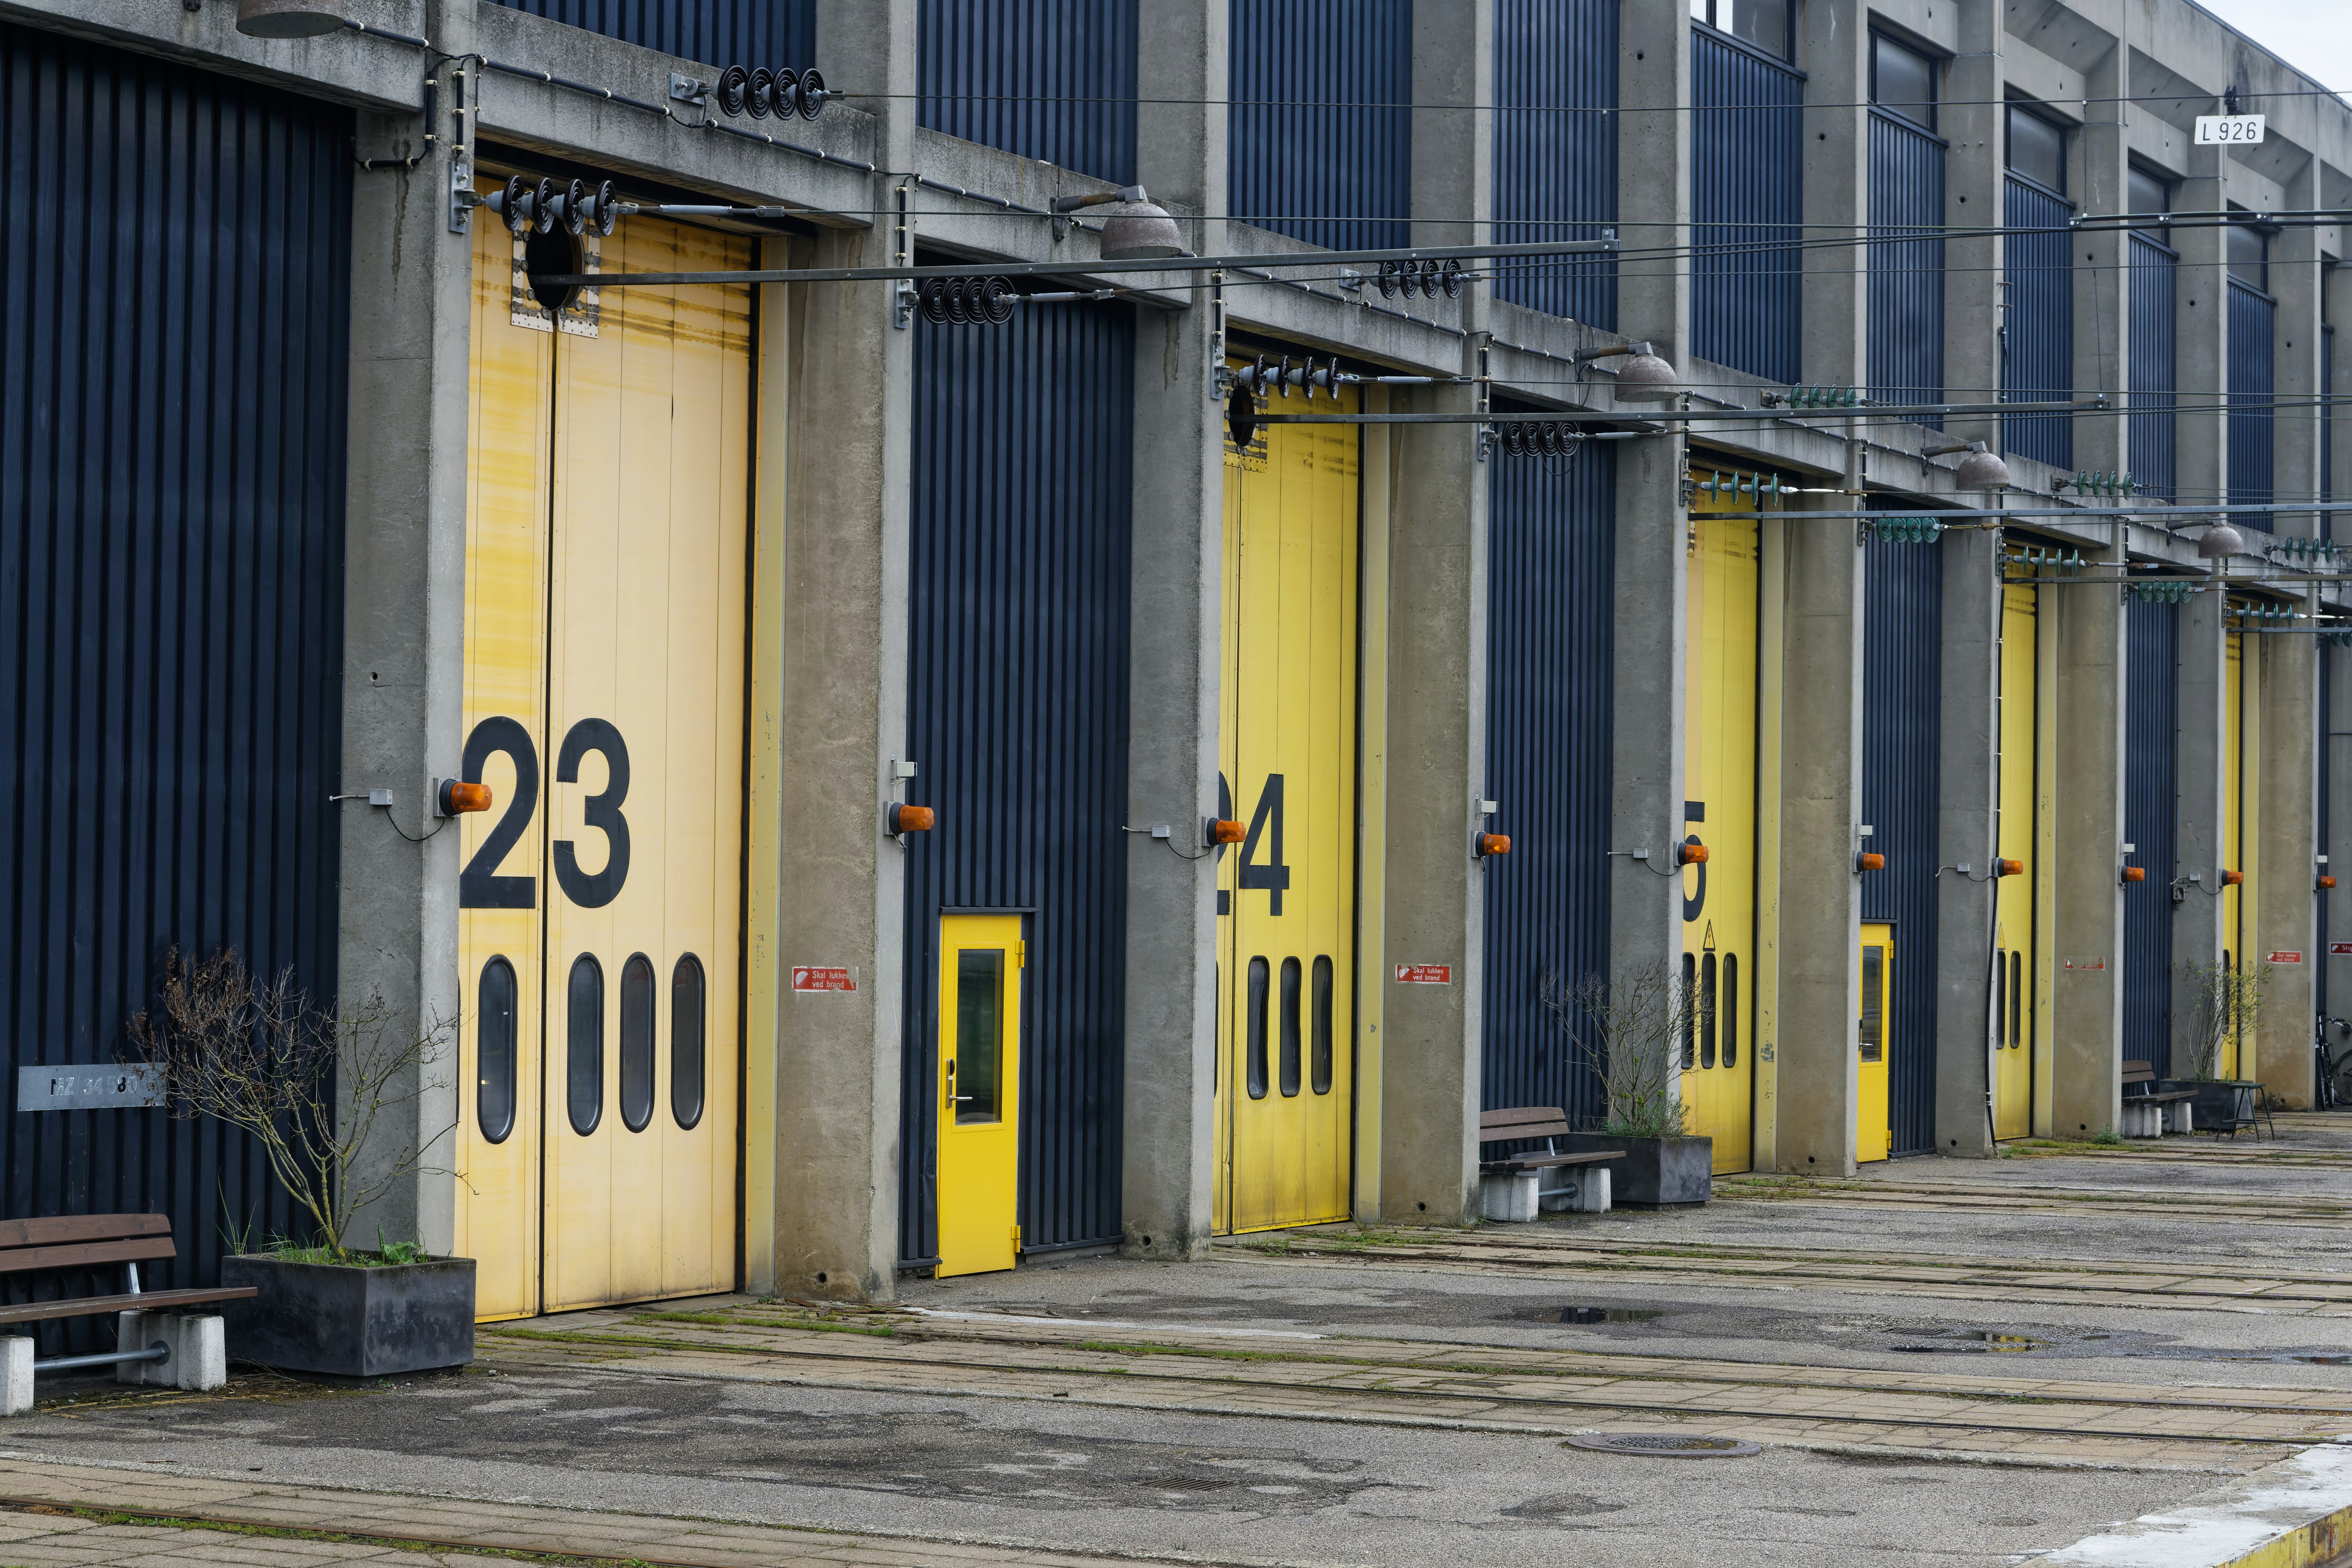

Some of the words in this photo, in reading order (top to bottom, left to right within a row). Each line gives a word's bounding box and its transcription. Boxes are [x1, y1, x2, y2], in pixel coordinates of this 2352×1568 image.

[2202, 123, 2210, 141] L
[2219, 122, 2256, 140] 926
[460, 716, 630, 908] 23
